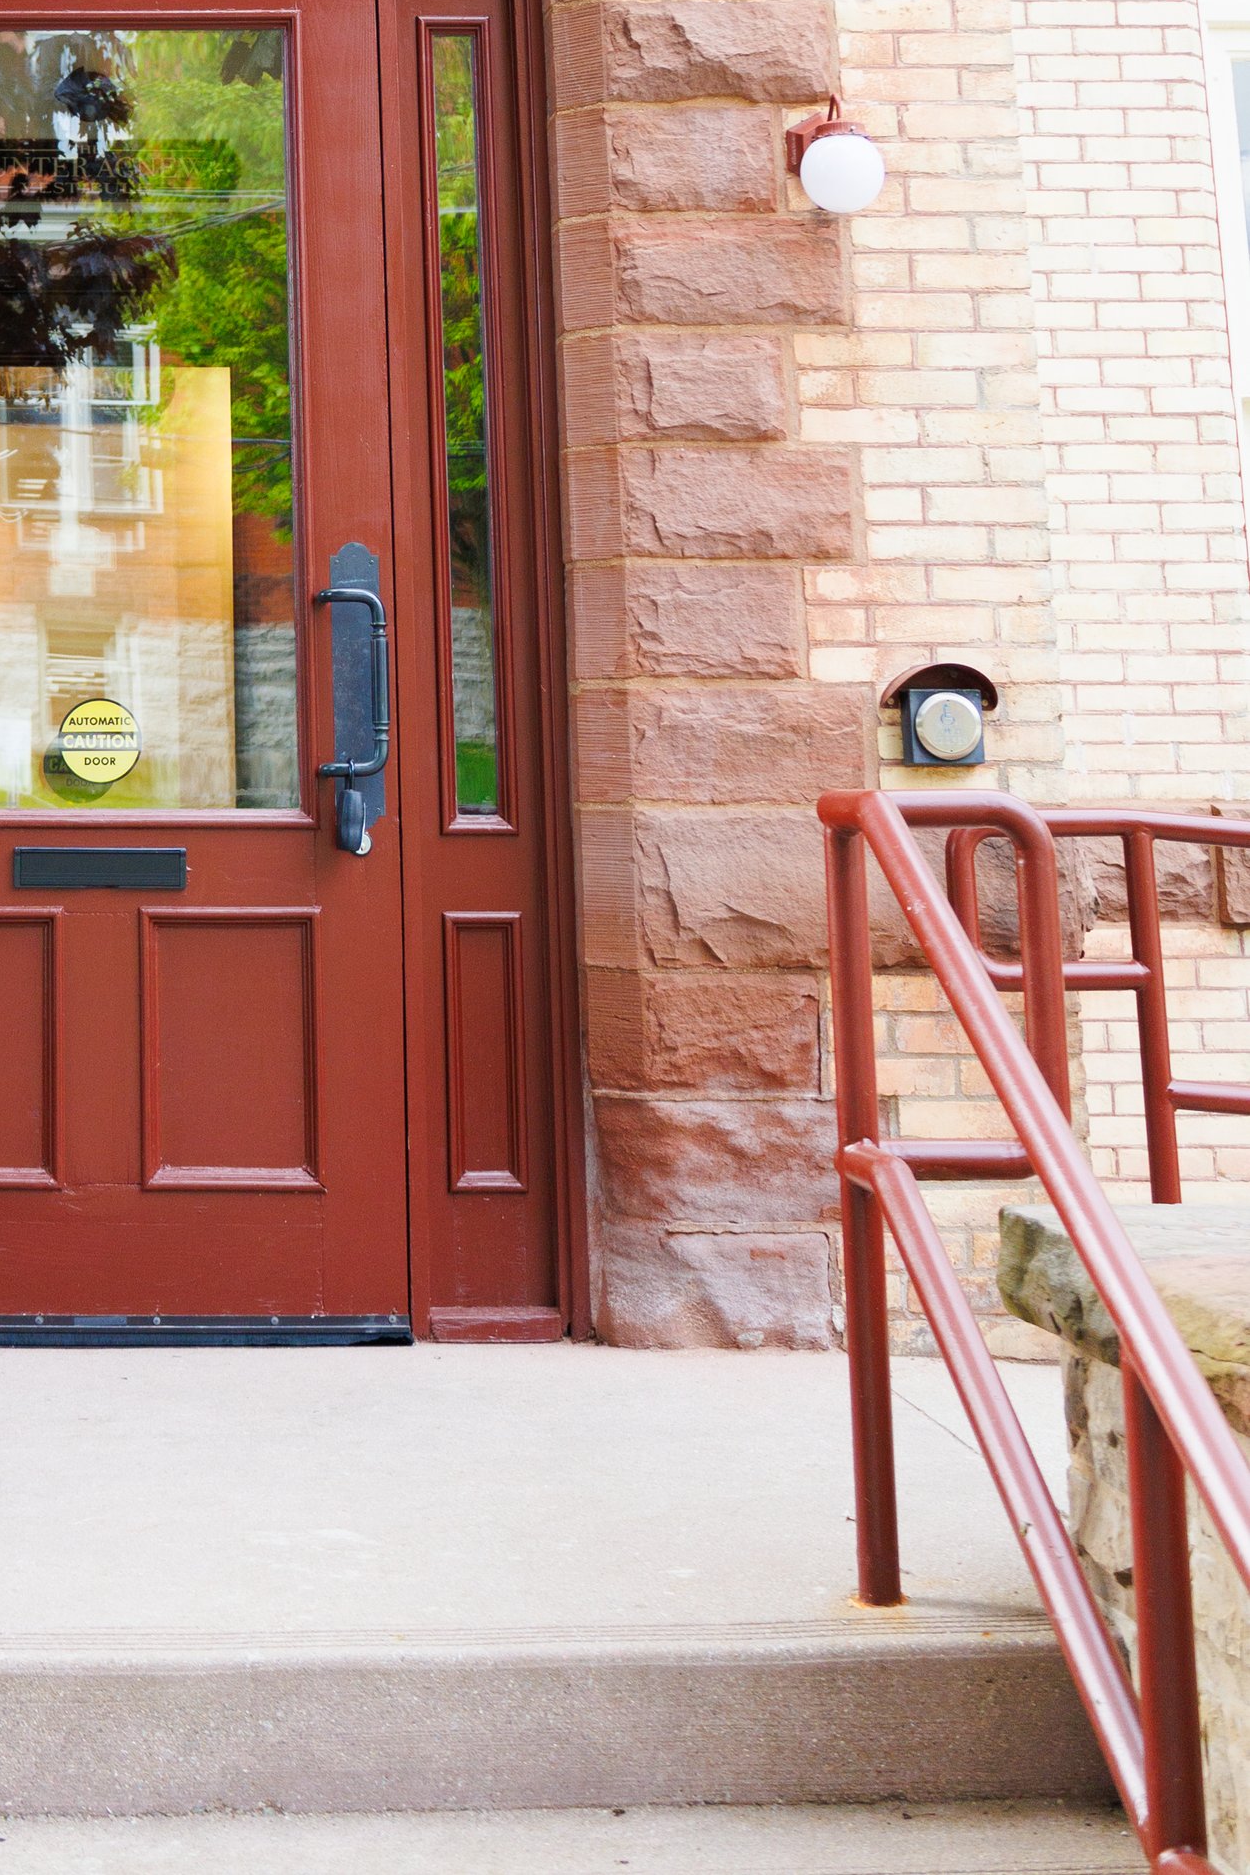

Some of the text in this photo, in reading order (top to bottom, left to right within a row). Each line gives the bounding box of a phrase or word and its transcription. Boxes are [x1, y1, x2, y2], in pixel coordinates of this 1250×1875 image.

[68, 717, 131, 726] AUTOMATIC
[63, 734, 137, 749] CAUTION
[84, 757, 116, 766] DOOR
